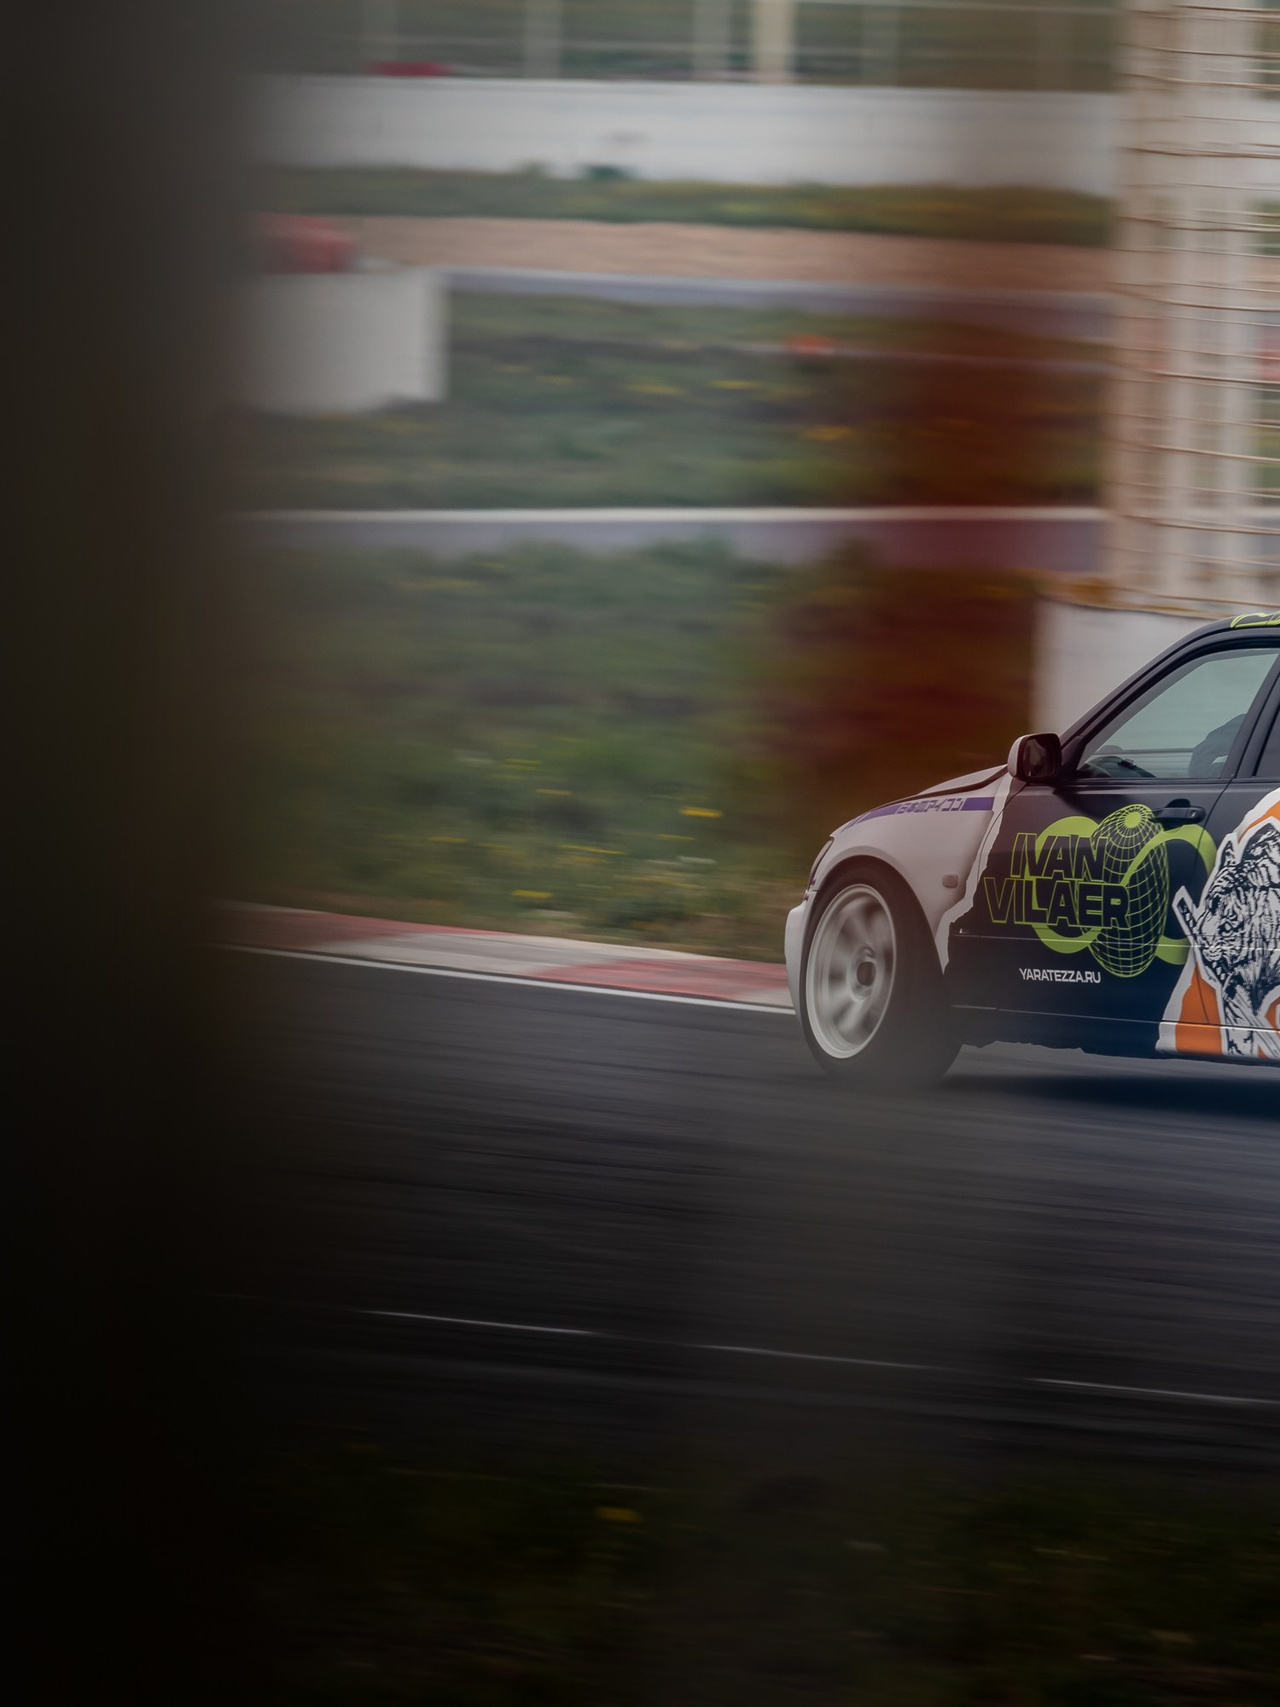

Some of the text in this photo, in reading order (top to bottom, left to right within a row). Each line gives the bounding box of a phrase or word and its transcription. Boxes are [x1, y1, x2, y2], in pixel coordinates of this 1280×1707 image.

[1010, 832, 1109, 883] IVAN
[983, 876, 1131, 931] VILAER
[1019, 967, 1102, 984] YARATEZZA.RU
